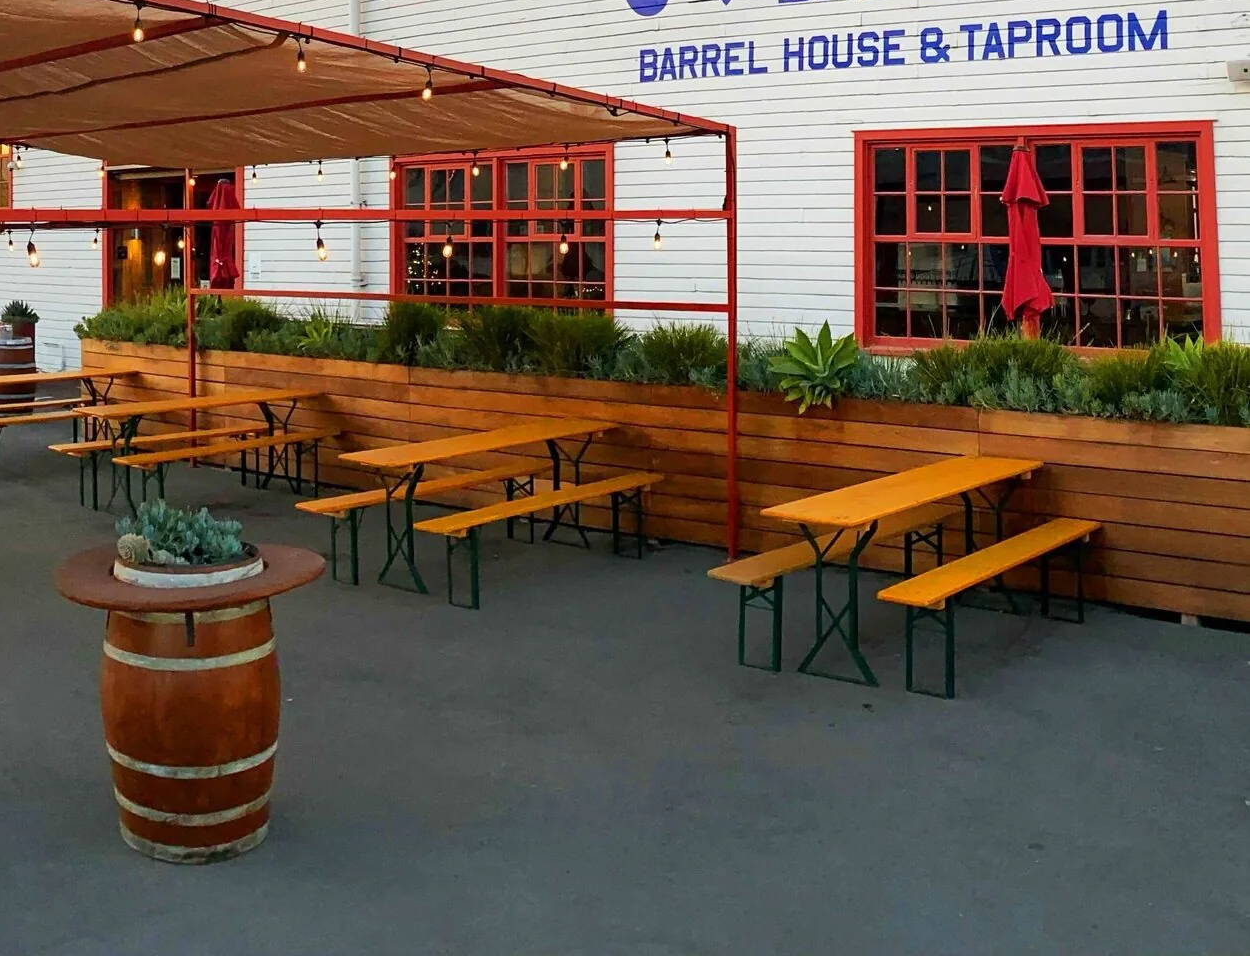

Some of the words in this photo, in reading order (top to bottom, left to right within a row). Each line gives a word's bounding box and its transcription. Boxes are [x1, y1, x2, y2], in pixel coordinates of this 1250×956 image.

[639, 40, 769, 84] BARREL
[782, 28, 906, 72] HOUSE
[919, 26, 951, 65] &
[957, 8, 1170, 62] TAPROOM
